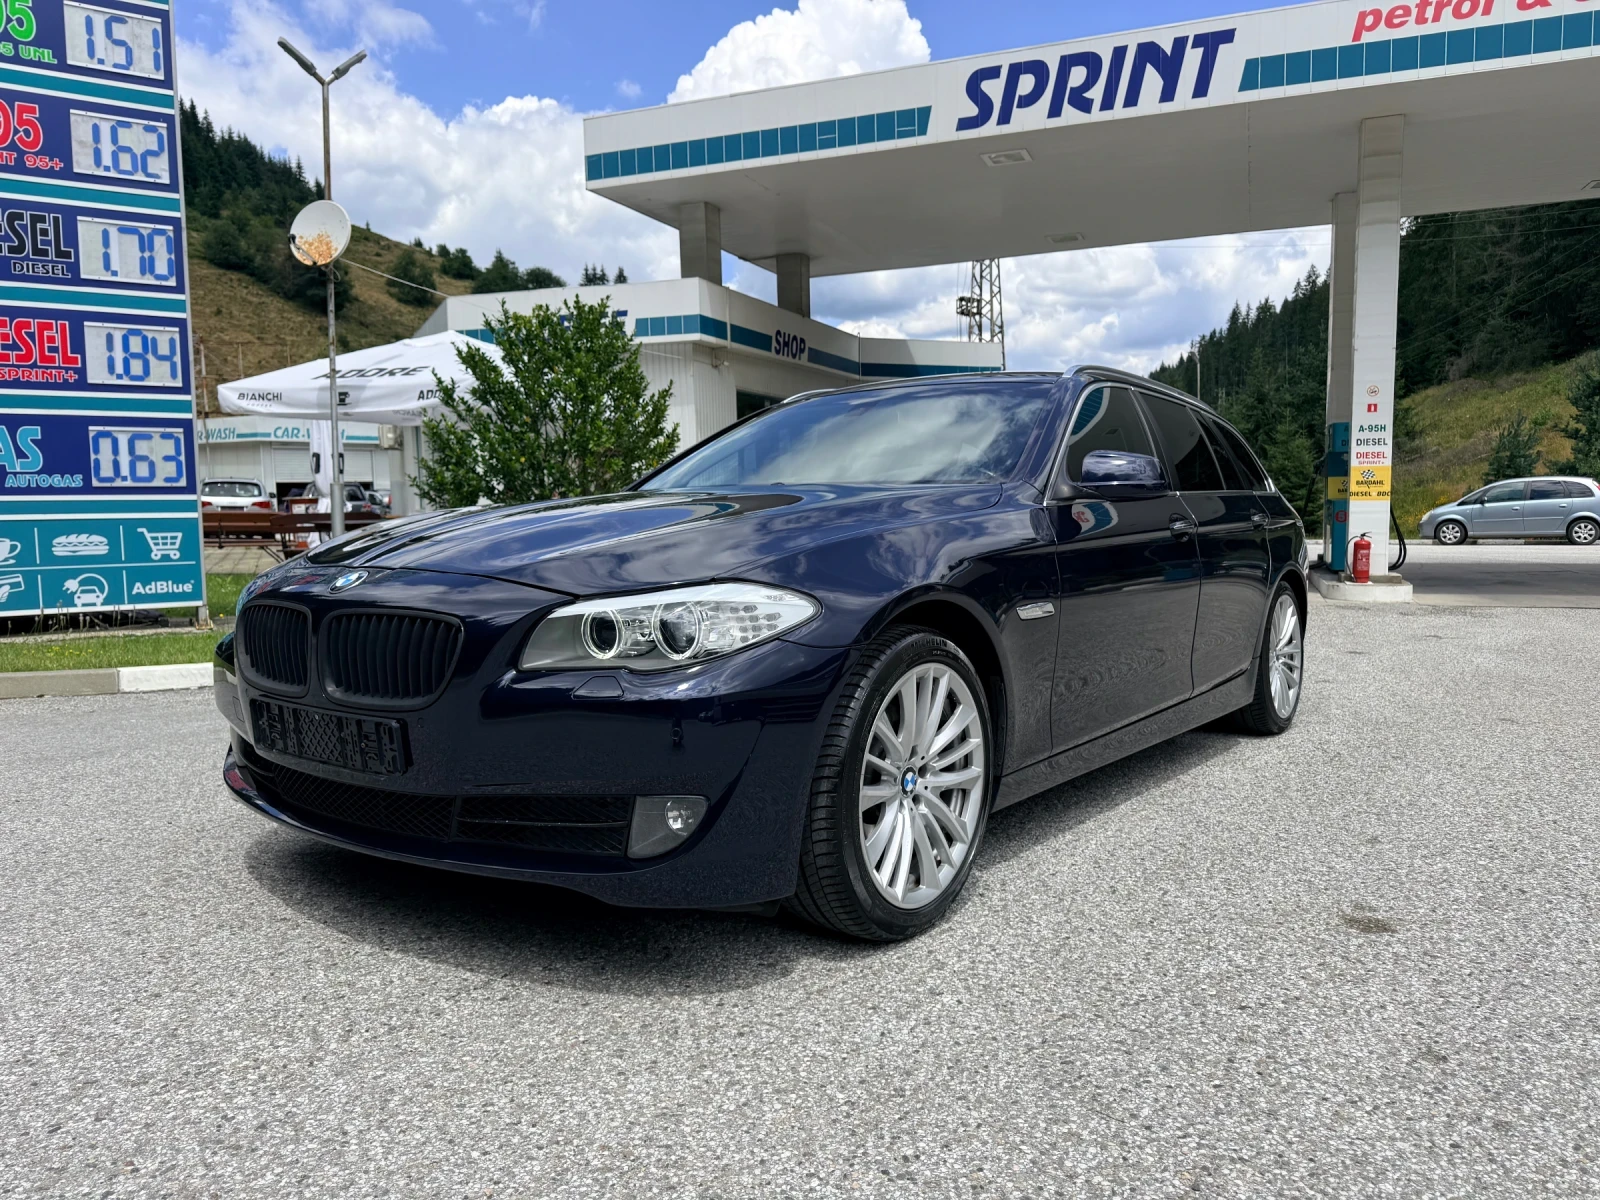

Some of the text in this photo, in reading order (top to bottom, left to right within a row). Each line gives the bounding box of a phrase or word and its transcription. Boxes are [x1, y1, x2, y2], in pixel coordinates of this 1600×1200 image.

[0, 0, 36, 41] 5
[0, 41, 57, 64] 5 UNL
[84, 14, 161, 72] 1.51
[955, 27, 1237, 132] SPRINT
[92, 120, 165, 178] 1.62
[24, 153, 64, 170] 95+
[0, 208, 74, 262] SEL
[101, 226, 175, 281] 1.70
[11, 260, 71, 278] DIESEL
[105, 328, 177, 382] 1.84
[774, 329, 806, 361] SHOP
[0, 366, 78, 383] SPRINT+
[237, 391, 283, 402] BIANCHI
[1358, 424, 1386, 433] A-95H
[1356, 438, 1388, 447] DIESEL
[91, 430, 183, 483] 0.63
[1355, 451, 1387, 460] DIESEL
[5, 473, 83, 488] AUTOGAS
[1355, 479, 1386, 487] BARDAHL
